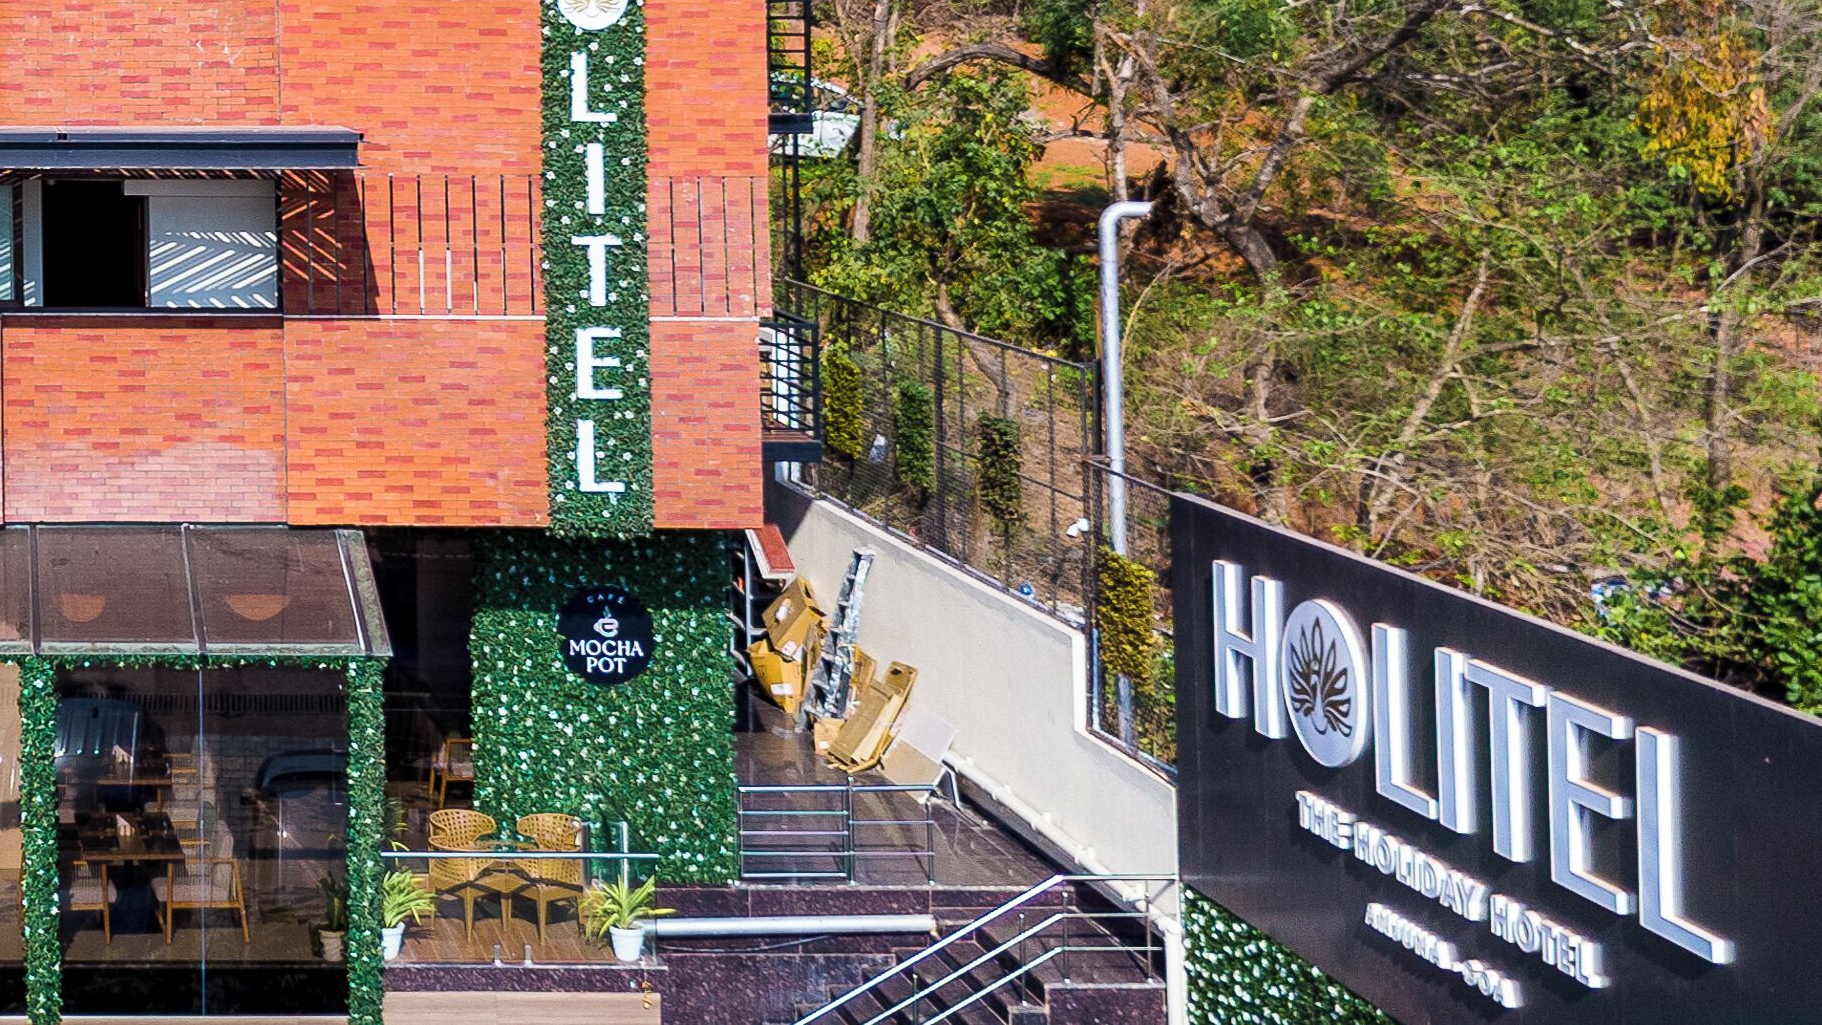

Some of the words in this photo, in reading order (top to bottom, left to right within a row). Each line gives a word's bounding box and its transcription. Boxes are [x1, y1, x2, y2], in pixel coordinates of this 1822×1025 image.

[569, 639, 645, 657] MOCHA
[586, 656, 627, 674] POT
[1212, 559, 1734, 964] HOLITEL
[1295, 790, 1357, 850] THE
[1353, 821, 1488, 922] HOLIDAY
[1490, 894, 1608, 989] HOTEL
